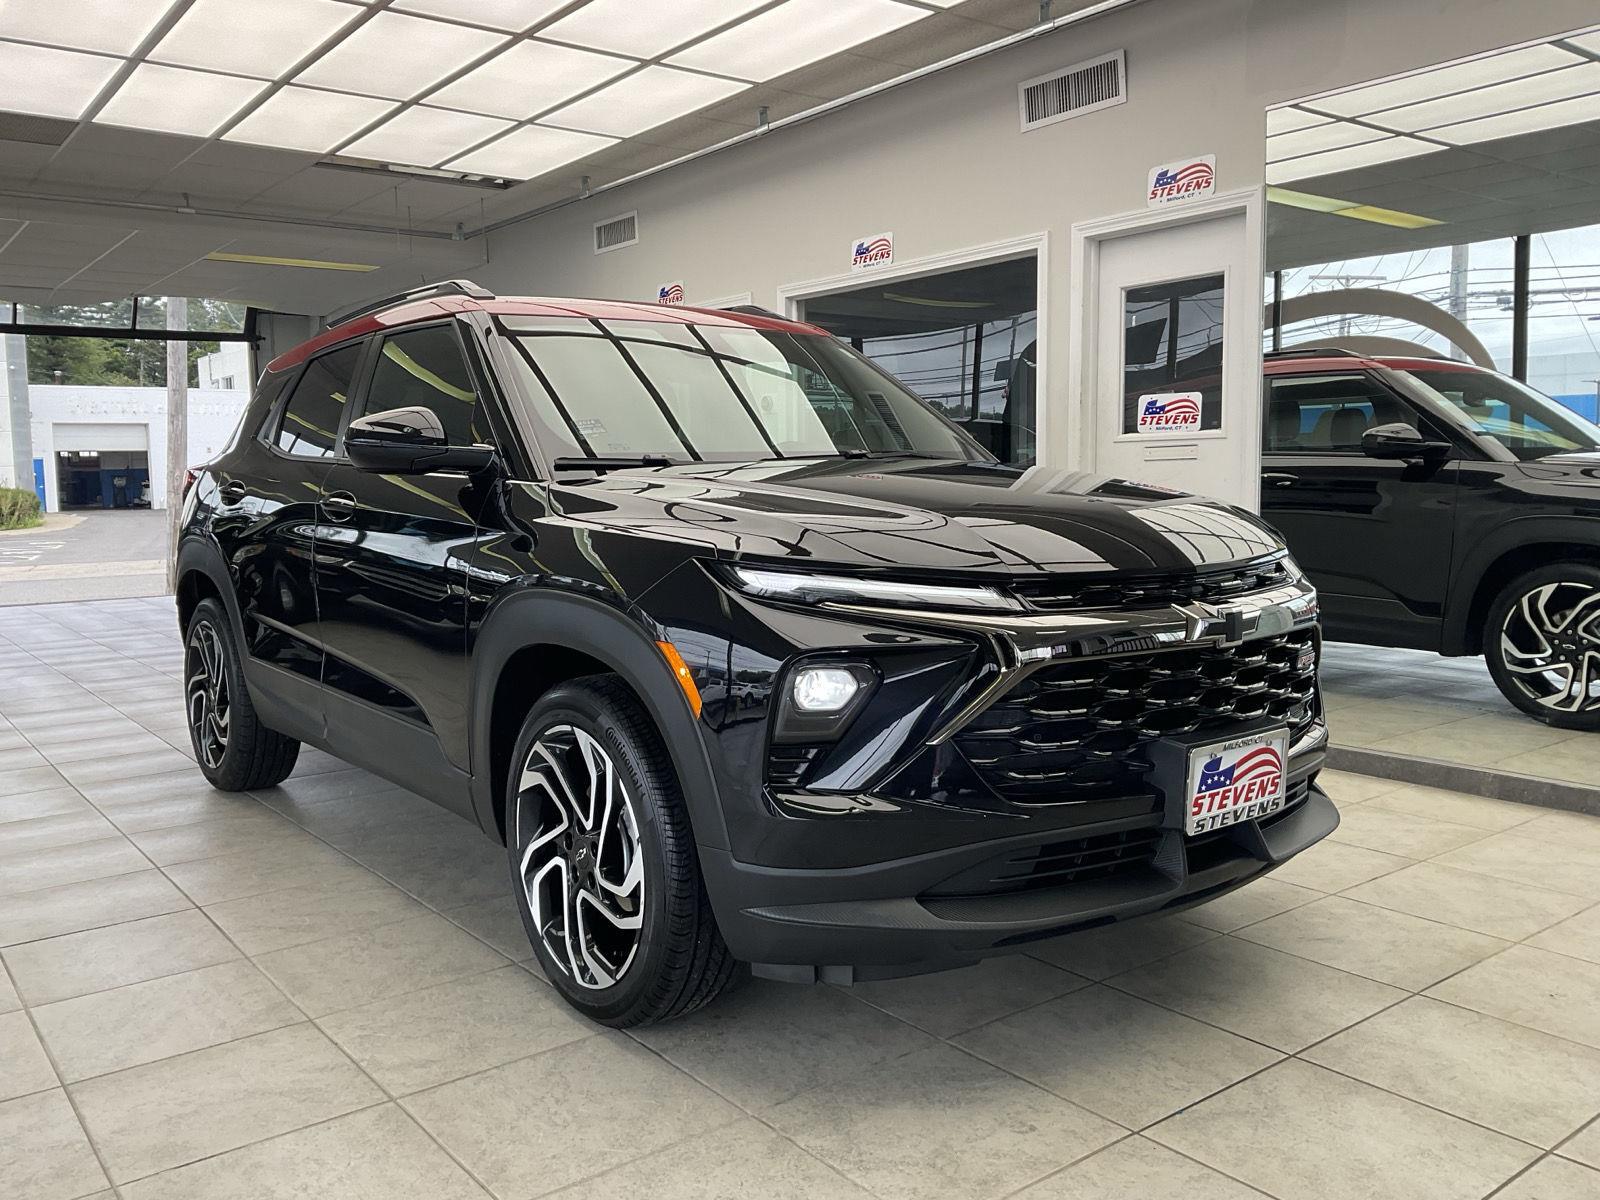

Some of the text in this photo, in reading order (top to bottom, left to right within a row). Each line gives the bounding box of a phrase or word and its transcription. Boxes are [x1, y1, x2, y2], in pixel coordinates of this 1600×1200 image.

[1149, 177, 1213, 200] STEVENS
[852, 250, 891, 265] STEVENS
[1139, 414, 1199, 425] STEVENS
[605, 726, 643, 790] Continental
[1192, 775, 1281, 816] STEVENS
[1194, 797, 1281, 833] STEVENS
